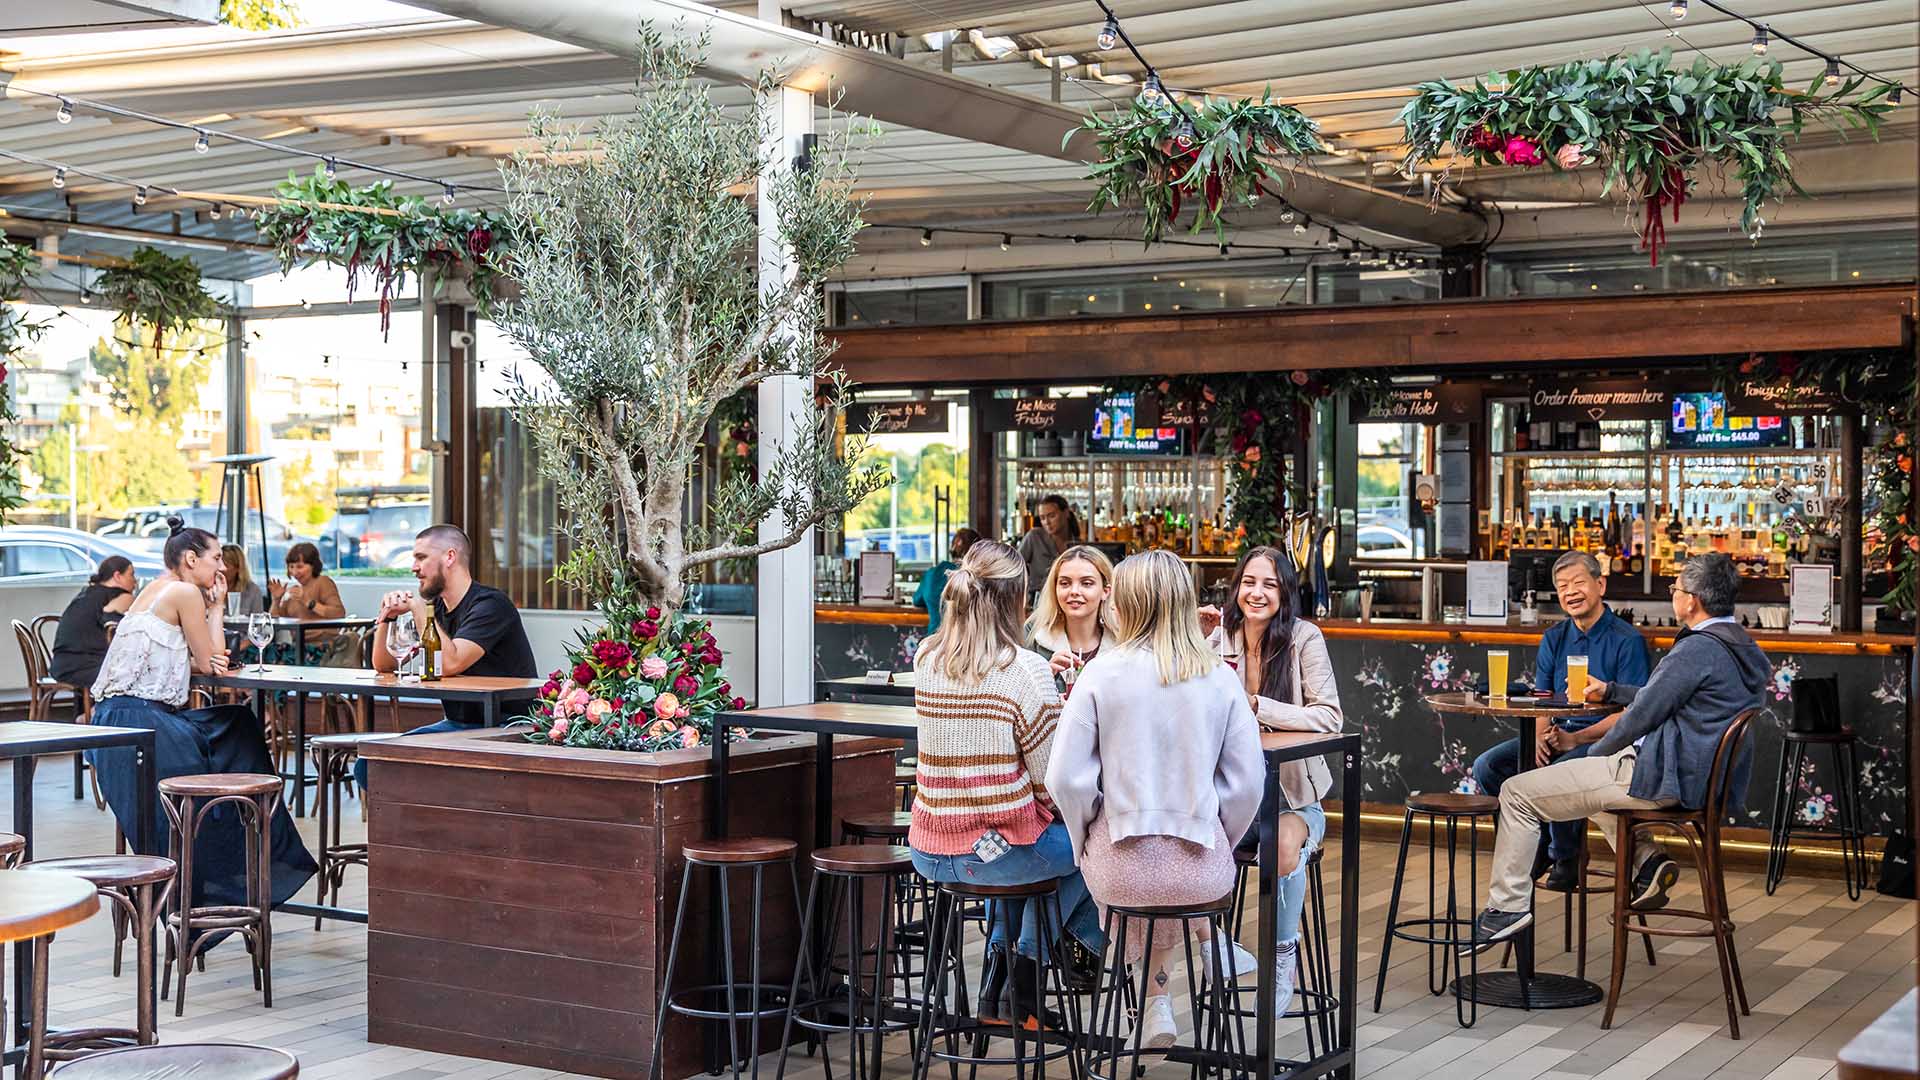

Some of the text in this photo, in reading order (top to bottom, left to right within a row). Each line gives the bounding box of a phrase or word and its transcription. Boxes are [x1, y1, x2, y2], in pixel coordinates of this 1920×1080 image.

[1424, 388, 1433, 400] to
[1534, 387, 1664, 406] Order from our menu here
[1016, 400, 1057, 411] Live Music
[1409, 401, 1439, 416] Hotel
[1015, 411, 1055, 429] Fridays
[1695, 433, 1714, 443] ANY
[1731, 431, 1760, 442] $45.00
[1814, 464, 1826, 478] 56
[1775, 487, 1792, 504] 64
[1806, 500, 1820, 513] 61
